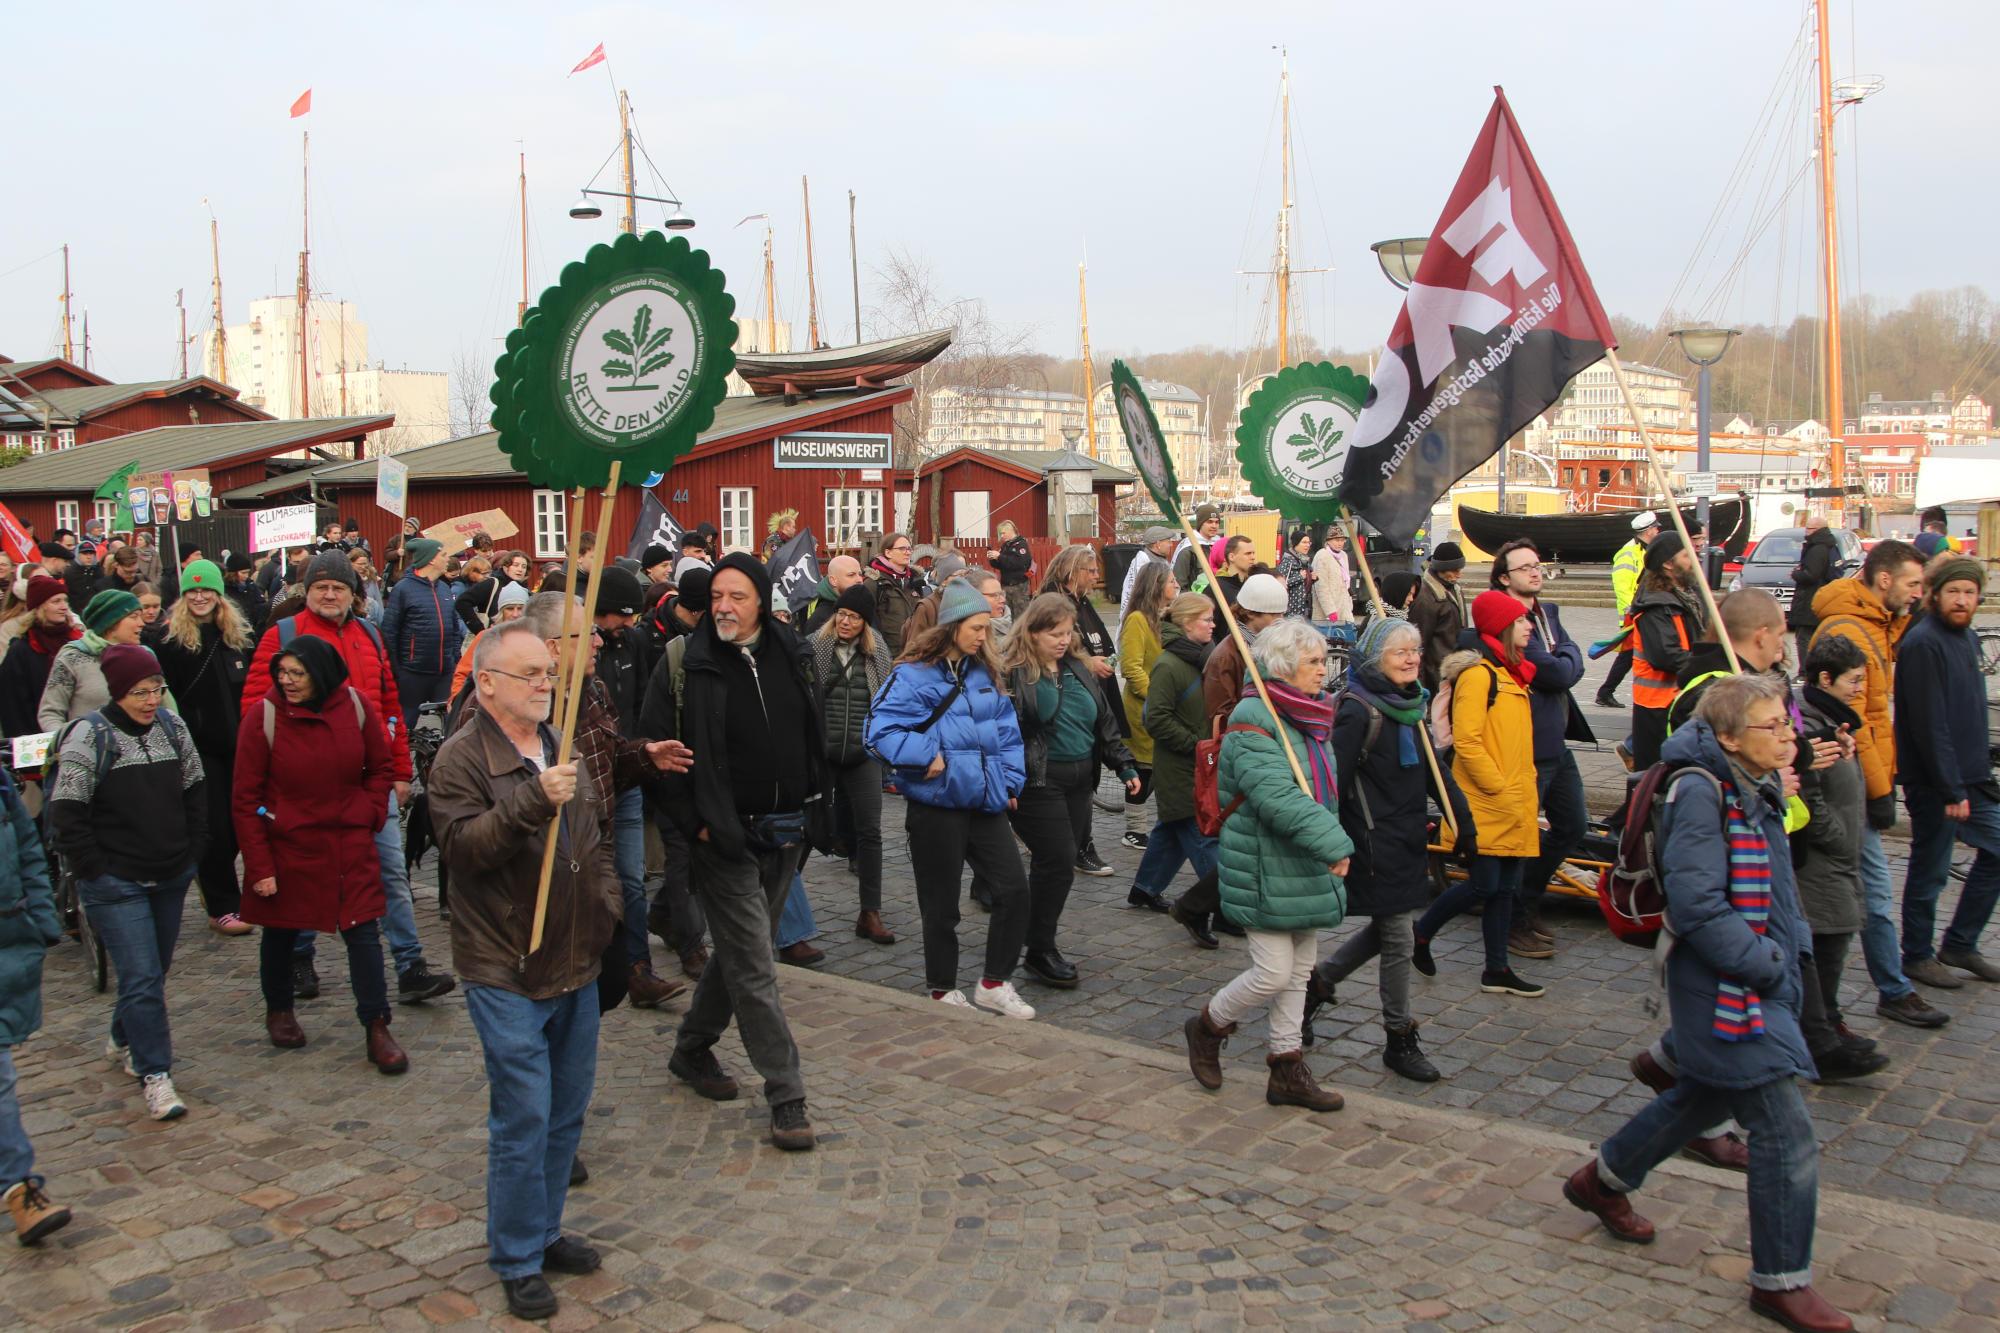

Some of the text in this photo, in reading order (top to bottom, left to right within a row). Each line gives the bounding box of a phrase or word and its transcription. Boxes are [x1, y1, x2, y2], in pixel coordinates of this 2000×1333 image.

[609, 278, 680, 296] Klimawald Flensburg
[560, 300, 601, 381] Klimawald Flensburg
[573, 368, 690, 430] RETTE DEN WALD
[780, 441, 886, 458] MUSEUMSWERFT
[1281, 466, 1319, 490] RETTE
[673, 488, 689, 504] 44
